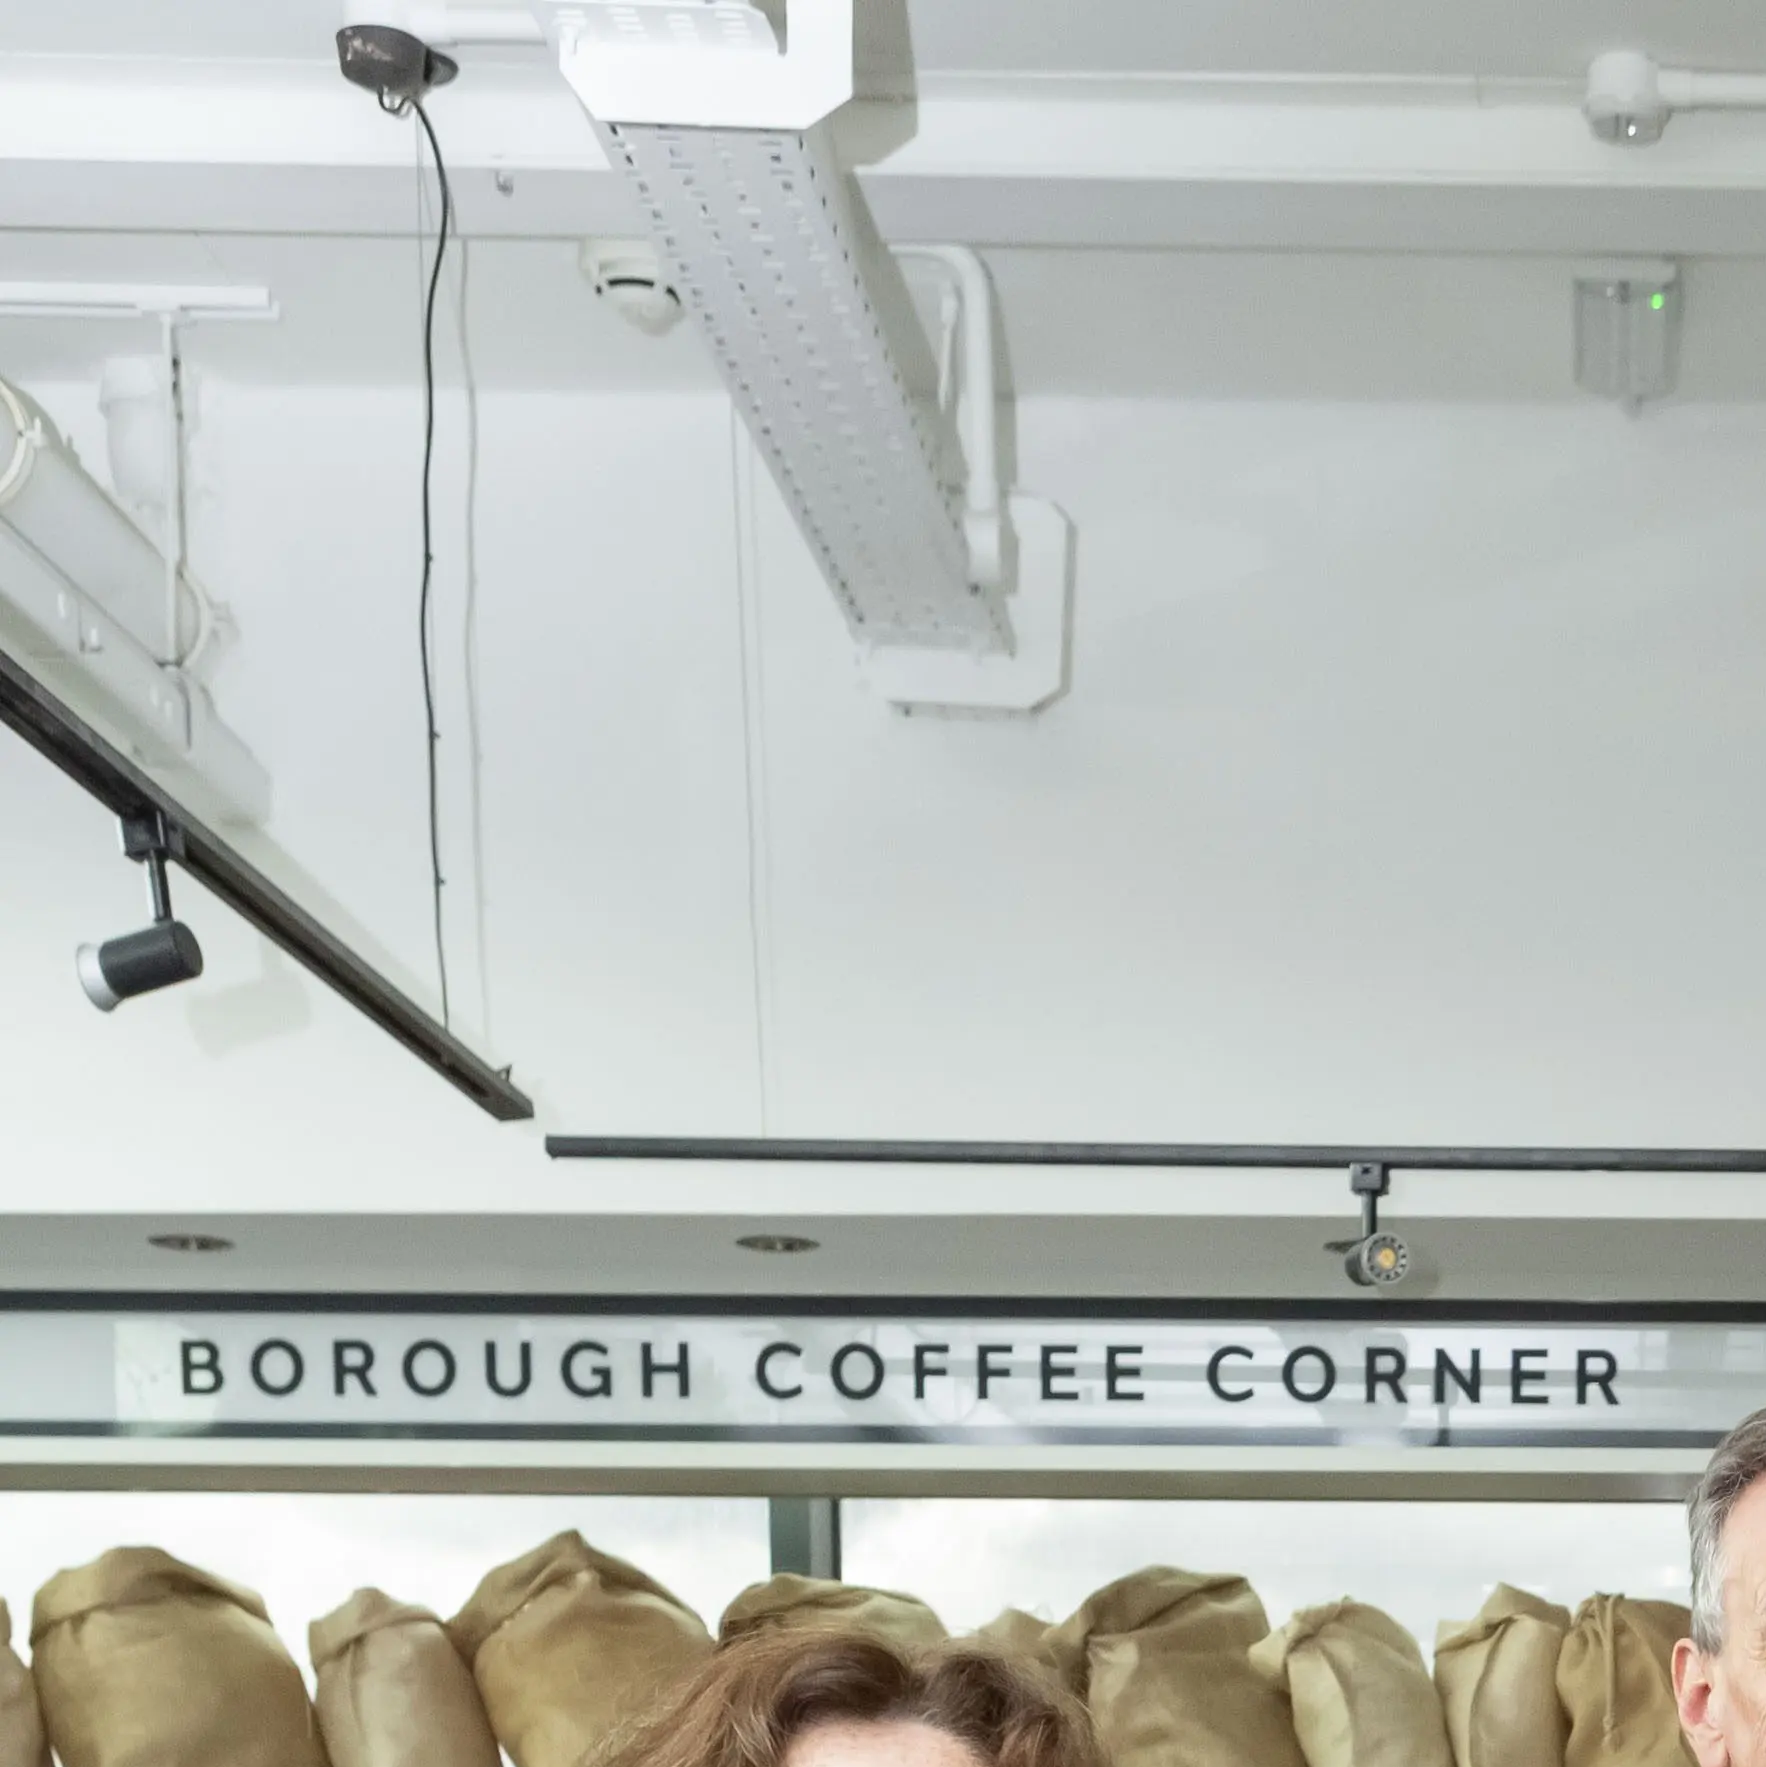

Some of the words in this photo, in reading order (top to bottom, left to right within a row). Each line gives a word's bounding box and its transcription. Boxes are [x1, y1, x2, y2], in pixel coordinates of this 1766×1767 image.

[181, 1339, 690, 1398] BOROUGH
[755, 1341, 1145, 1402] COFFEE
[1206, 1345, 1620, 1406] CORNER
